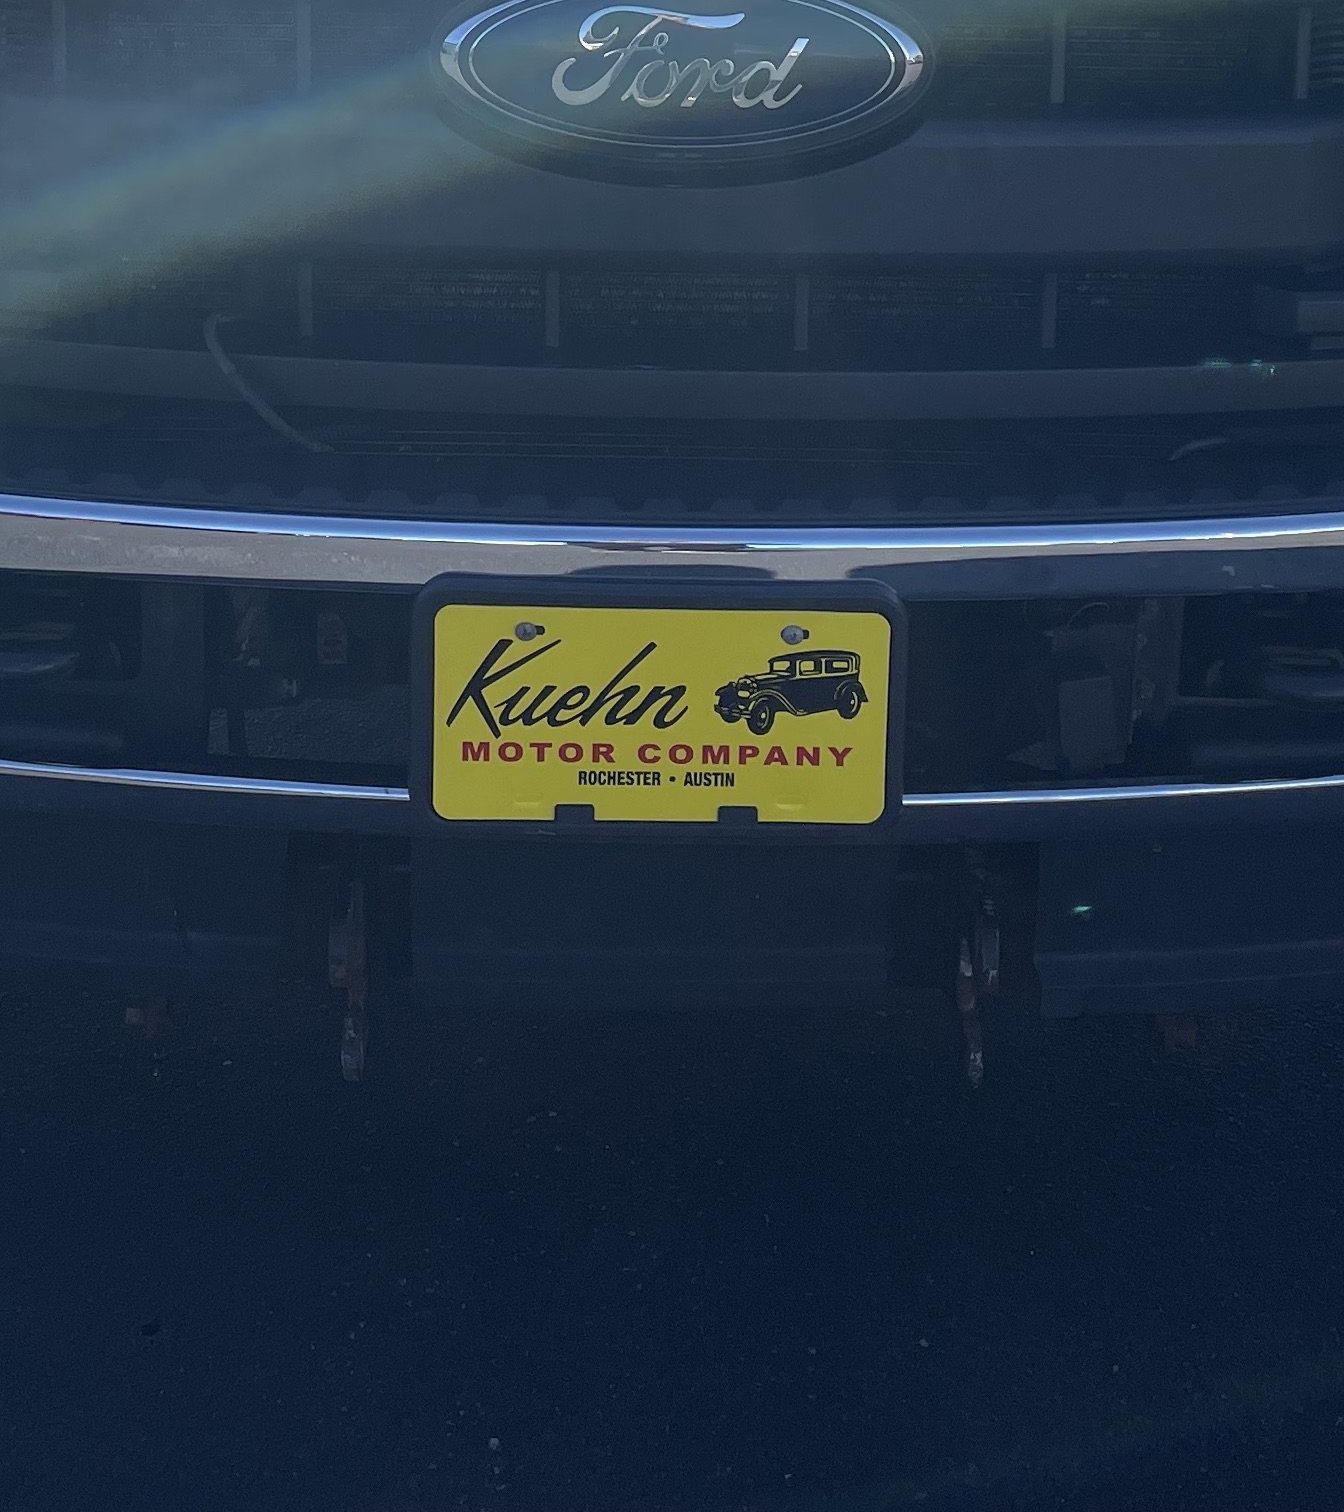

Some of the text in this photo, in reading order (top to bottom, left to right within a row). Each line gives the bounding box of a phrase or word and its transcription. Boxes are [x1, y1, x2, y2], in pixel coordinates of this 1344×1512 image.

[552, 5, 810, 110] Ford
[446, 638, 689, 739] Kuehn
[462, 741, 854, 767] MOTOR COMPANY
[578, 770, 735, 787] ROCHESTER AUSTIN
